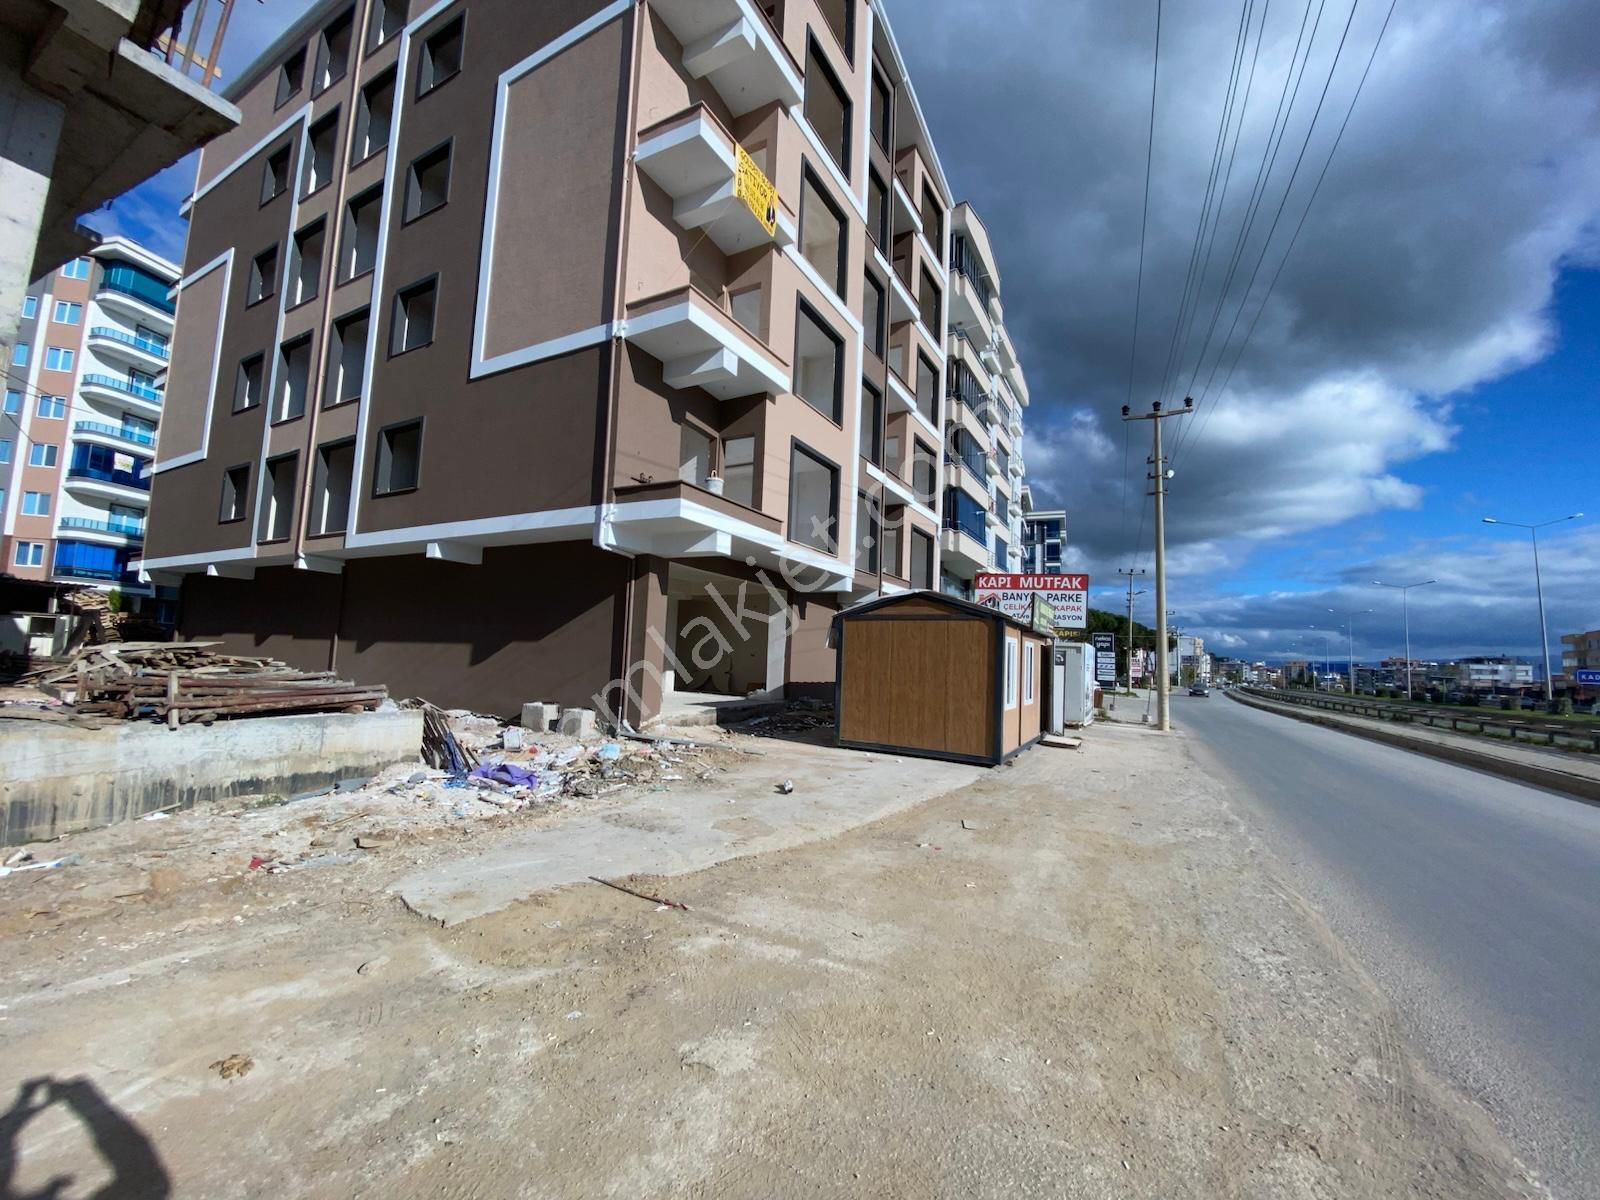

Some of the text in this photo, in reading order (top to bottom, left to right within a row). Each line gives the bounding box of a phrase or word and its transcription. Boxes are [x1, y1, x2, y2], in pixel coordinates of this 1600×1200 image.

[978, 576, 1082, 590] KAPI MUTFAK
[1047, 593, 1082, 603] PARKE
